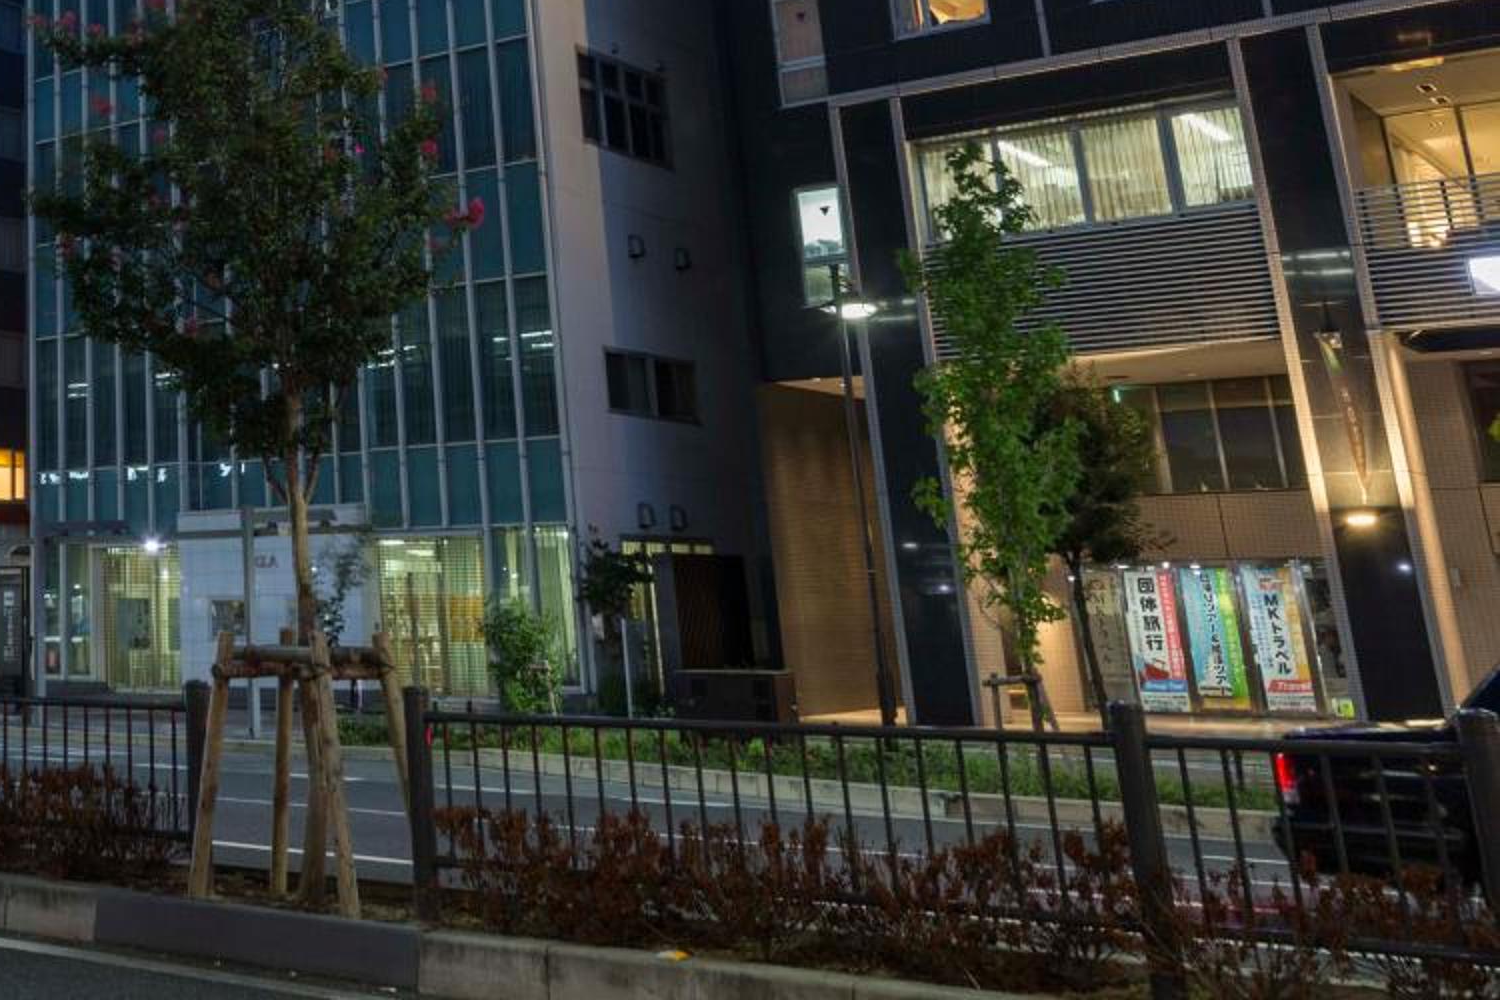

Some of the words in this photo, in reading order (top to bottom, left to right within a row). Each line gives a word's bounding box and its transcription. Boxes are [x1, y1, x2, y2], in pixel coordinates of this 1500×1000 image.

[1138, 578, 1163, 651] 団体旅行
[1264, 594, 1292, 675] MKトラベル
